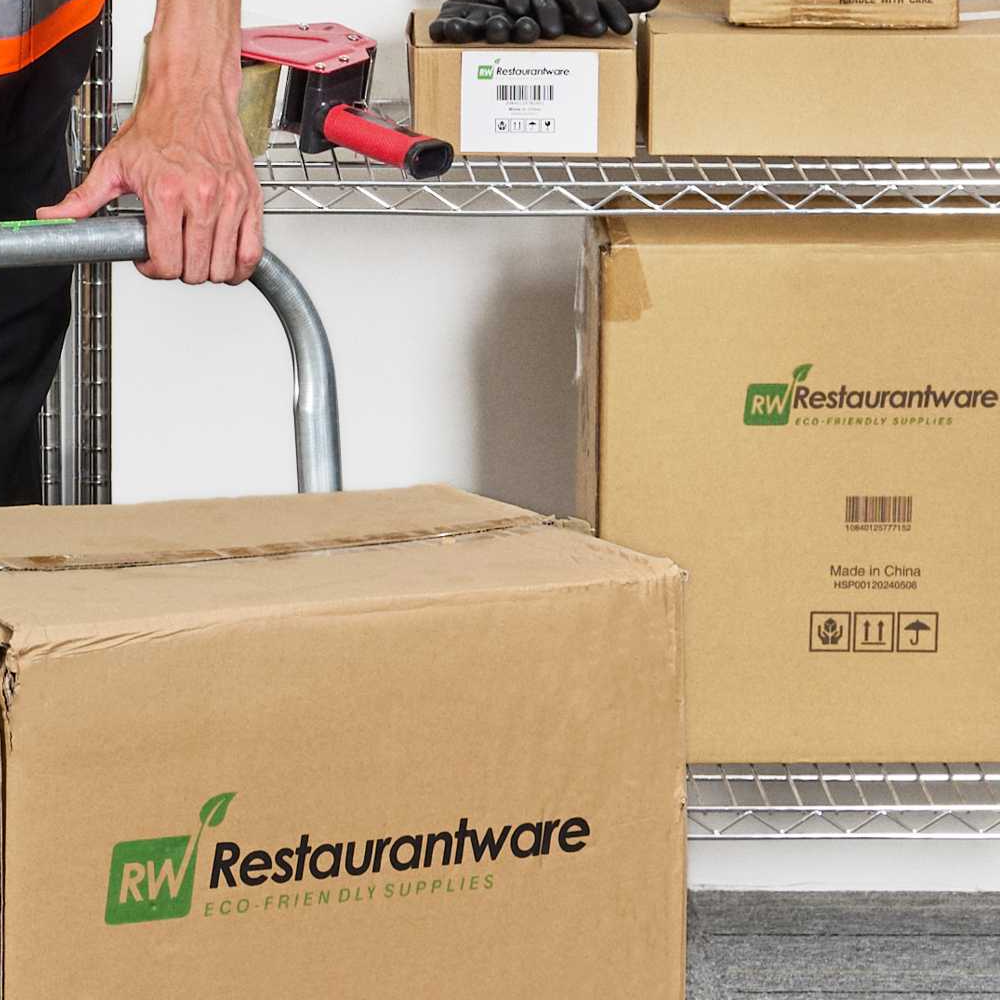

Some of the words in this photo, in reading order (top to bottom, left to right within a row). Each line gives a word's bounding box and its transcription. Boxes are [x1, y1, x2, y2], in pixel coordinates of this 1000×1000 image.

[496, 67, 570, 76] Restaurantware
[751, 394, 788, 415] RW
[793, 384, 999, 409] Restaurantware
[795, 417, 887, 426] ECO-FRIENDLY
[892, 417, 953, 425] SUPPLIES
[830, 565, 865, 577] Made
[869, 565, 880, 577] in
[884, 565, 921, 577] China
[119, 858, 187, 904] RW
[209, 816, 590, 889] Restaurantware
[384, 874, 495, 898] SUPPLIES
